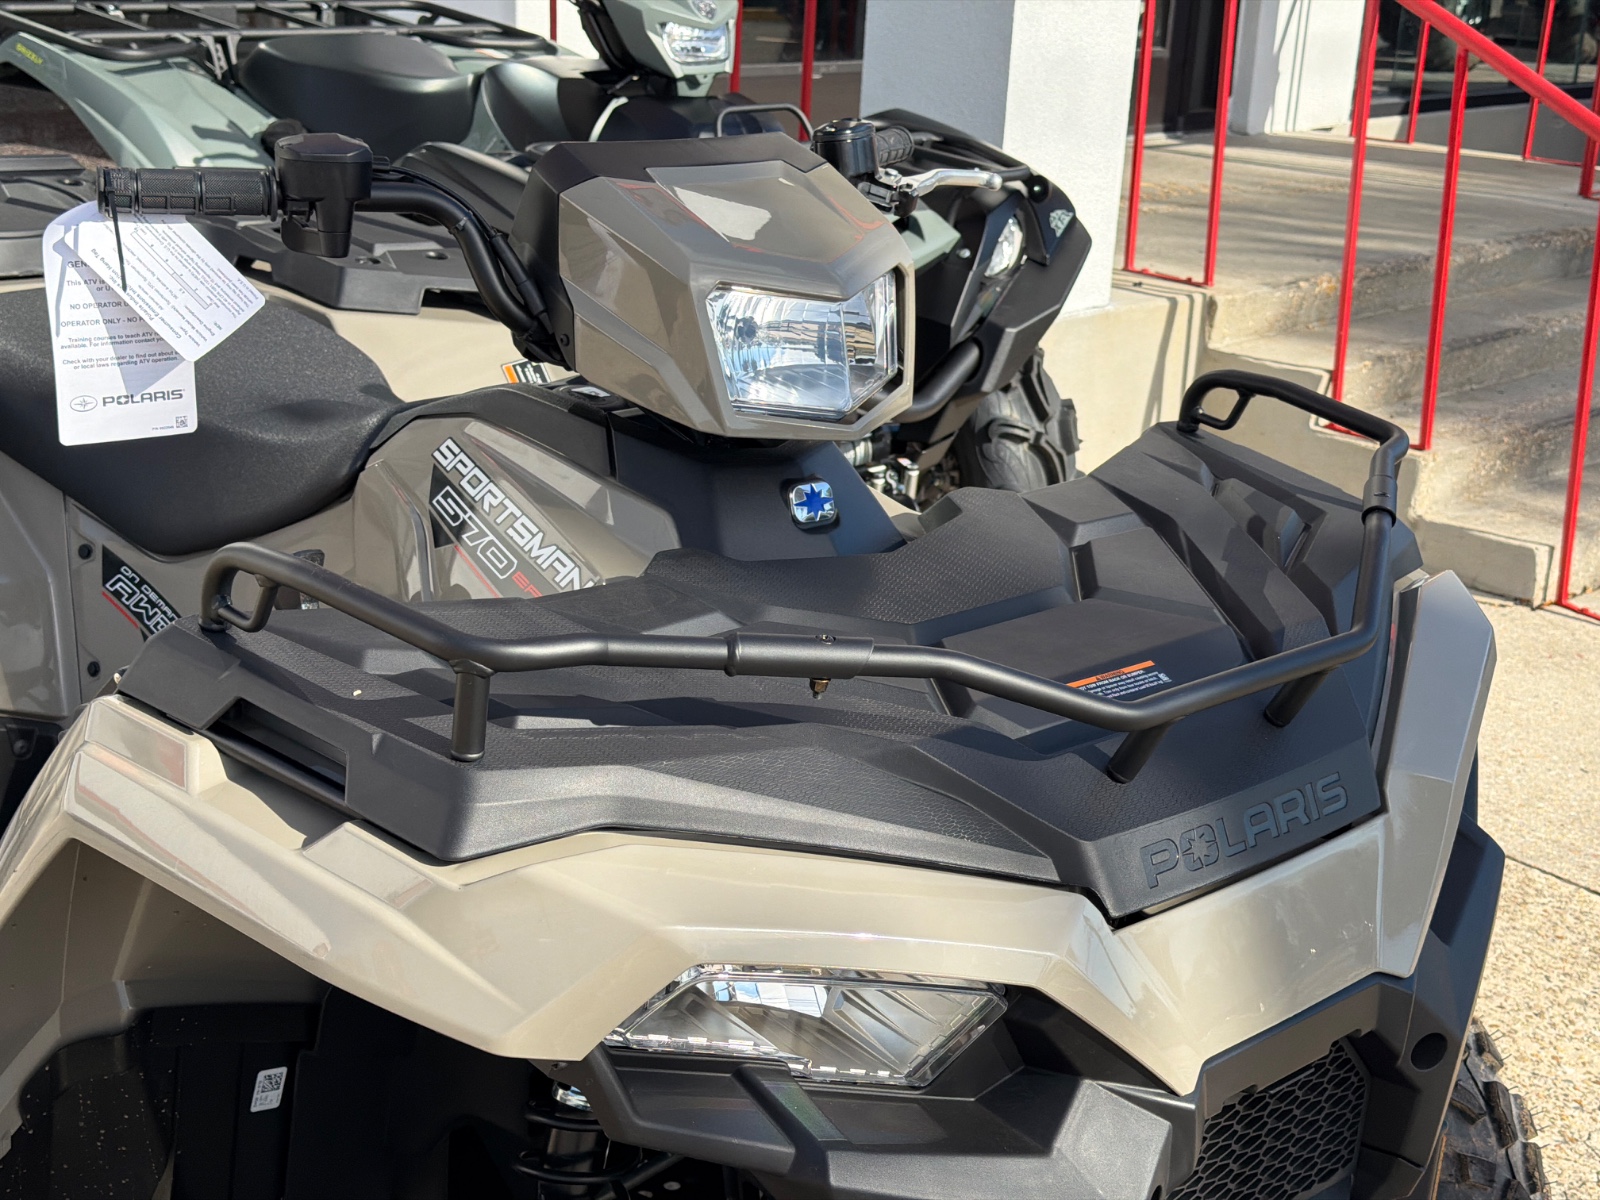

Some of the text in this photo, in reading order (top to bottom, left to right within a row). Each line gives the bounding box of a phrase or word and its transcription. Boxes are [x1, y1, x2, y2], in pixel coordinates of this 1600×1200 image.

[67, 261, 90, 269] GEN
[60, 319, 100, 328] OPERATOR
[82, 301, 122, 310] OPERATOR
[102, 389, 184, 407] POLARIS
[431, 437, 597, 591] SPORTSMAN
[432, 485, 518, 580] 570
[105, 574, 172, 634] AWD
[141, 584, 178, 620] DEMAN
[1139, 771, 1348, 890] POLARIS
